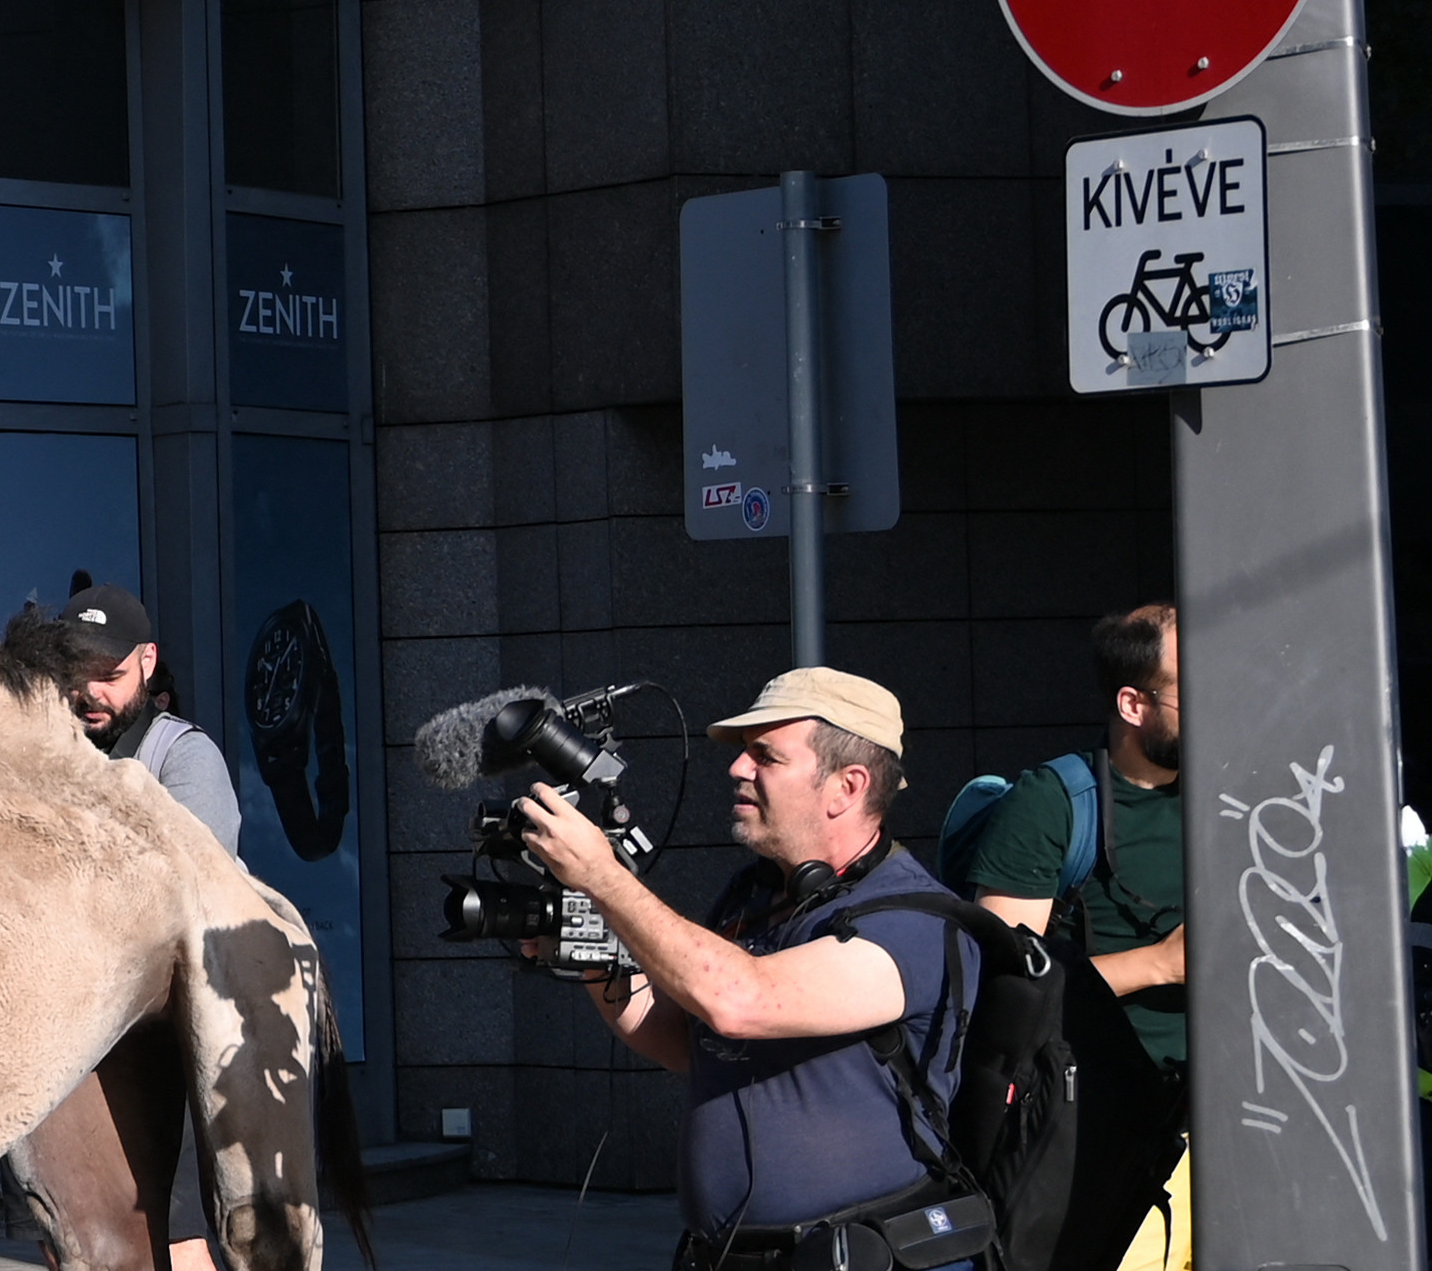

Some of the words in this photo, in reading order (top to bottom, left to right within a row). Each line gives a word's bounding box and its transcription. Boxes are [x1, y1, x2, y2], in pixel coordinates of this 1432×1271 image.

[1083, 148, 1245, 231] KIVÉVE
[0, 281, 116, 331] ZENITH
[239, 289, 338, 340] ZENITH
